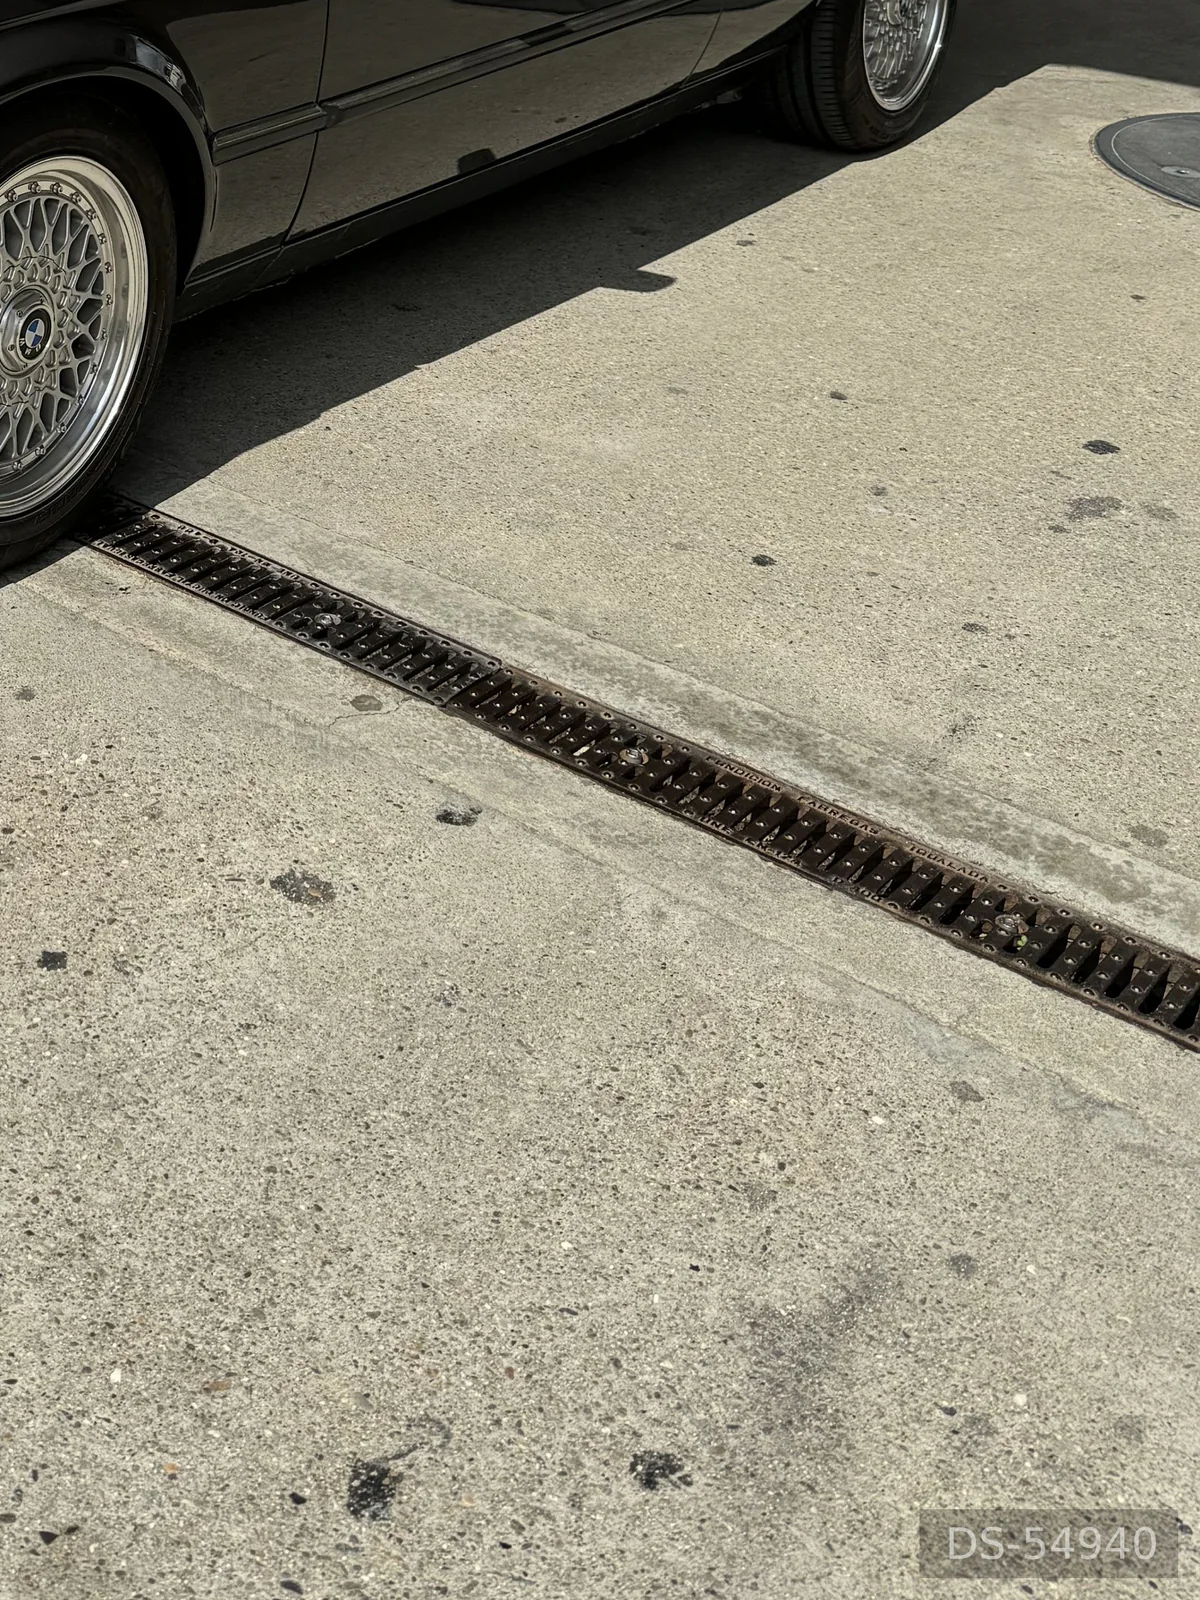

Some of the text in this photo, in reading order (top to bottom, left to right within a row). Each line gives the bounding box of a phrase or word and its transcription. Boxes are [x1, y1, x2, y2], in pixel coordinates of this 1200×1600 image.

[705, 755, 990, 885] FUNDICION FABREGAS IGUALADA
